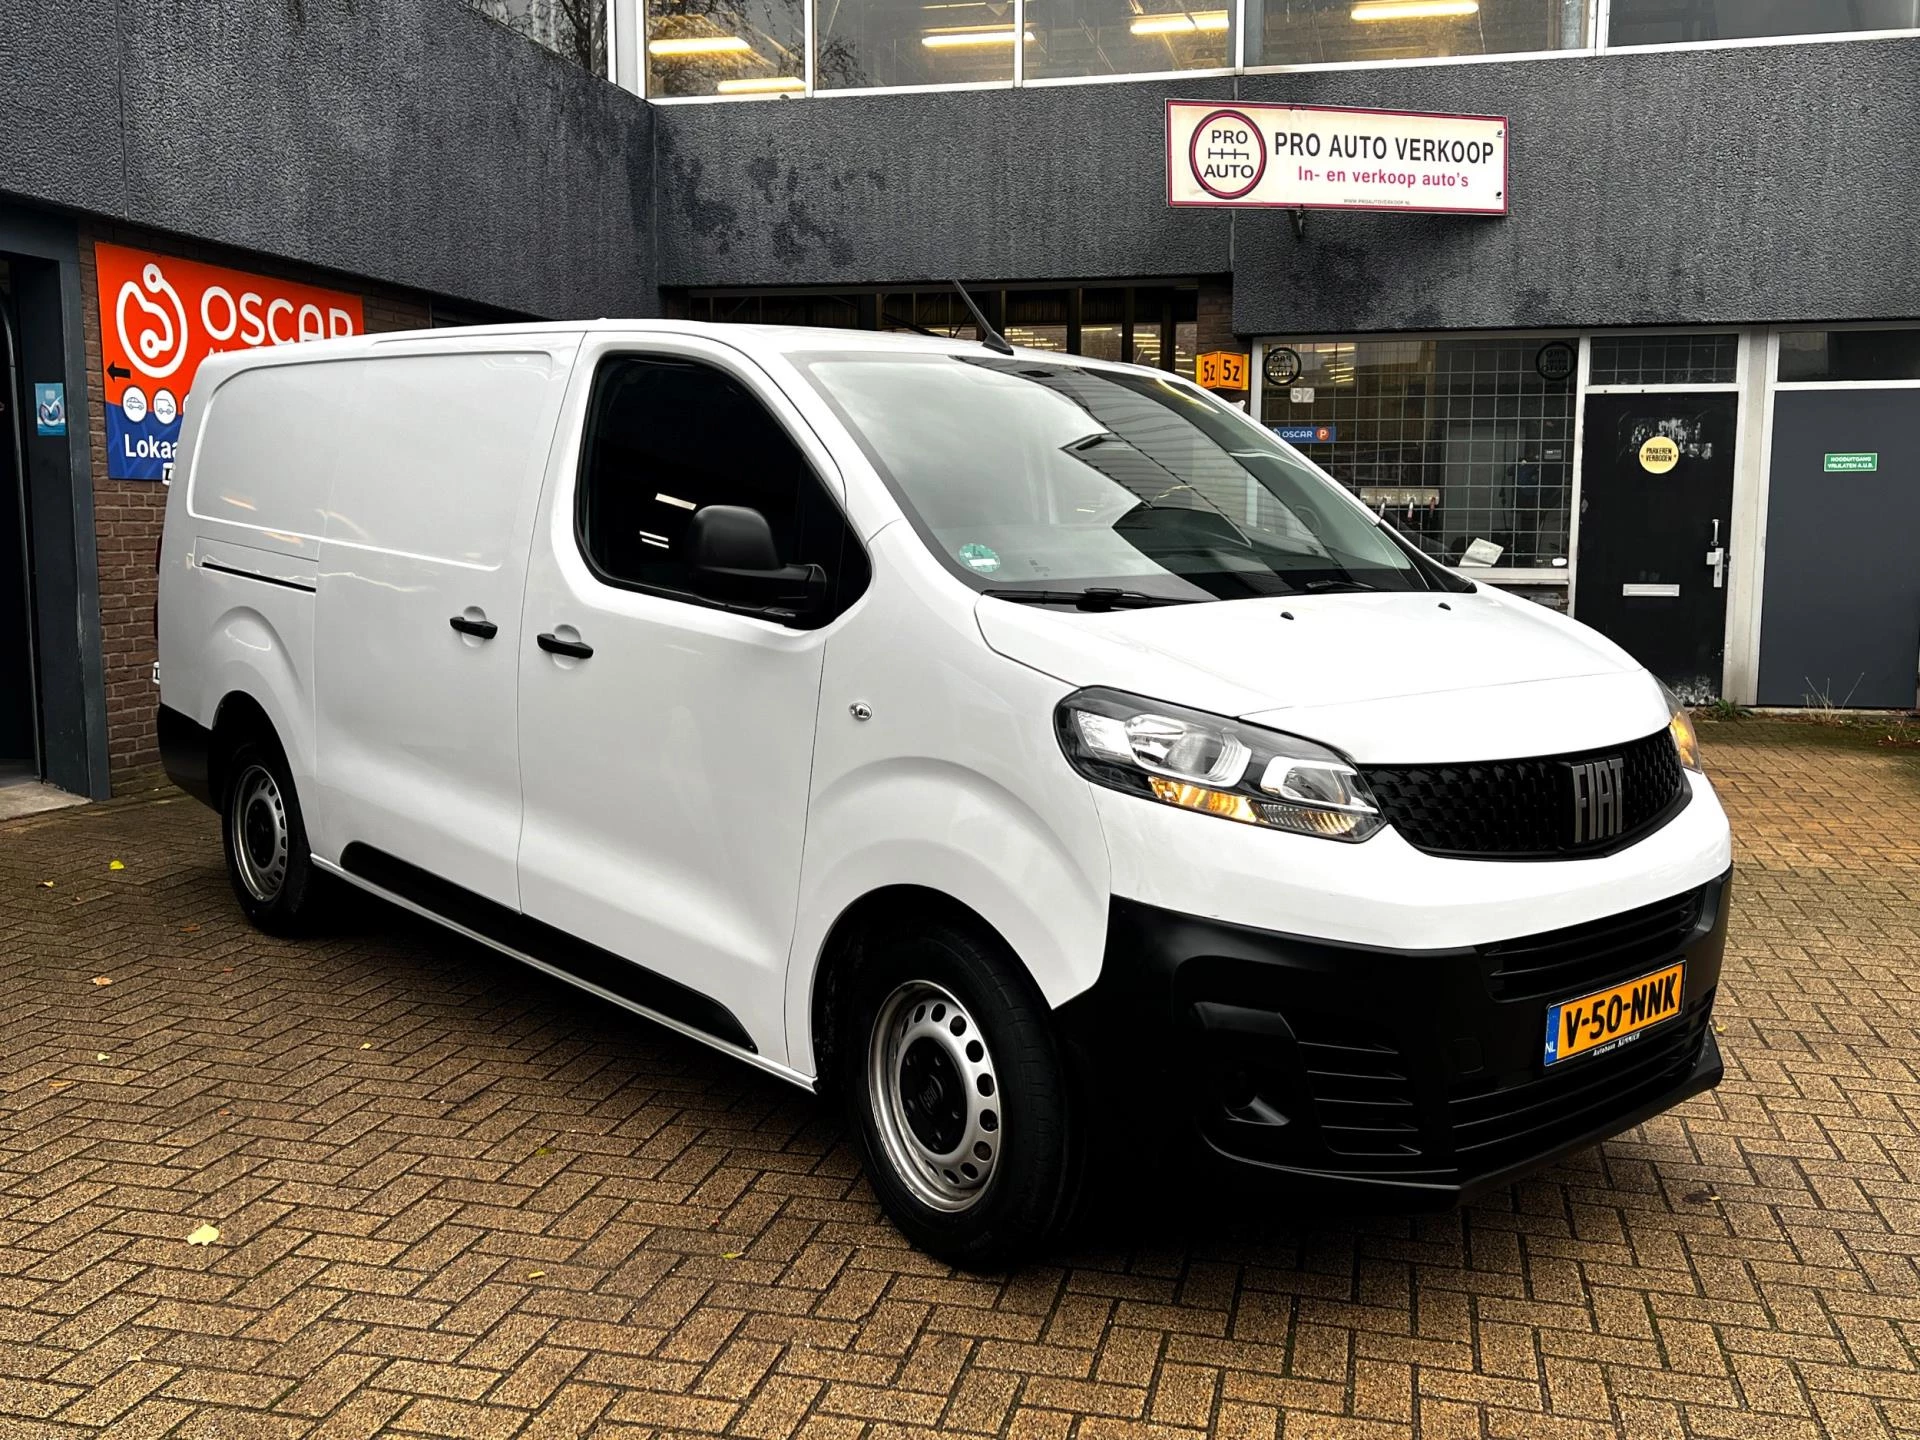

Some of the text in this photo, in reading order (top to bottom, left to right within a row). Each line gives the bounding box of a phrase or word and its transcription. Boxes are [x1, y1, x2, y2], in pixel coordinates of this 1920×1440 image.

[1211, 129, 1248, 145] PRO
[1275, 132, 1494, 164] PRO AUTO VERKOOP
[1203, 164, 1254, 179] AUTO
[1298, 165, 1469, 188] In- en verkoop auto's
[1281, 430, 1313, 438] OSCAR
[1570, 757, 1625, 843] FIAT
[1565, 972, 1678, 1049] V-50-NNK
[1545, 1040, 1556, 1054] NL
